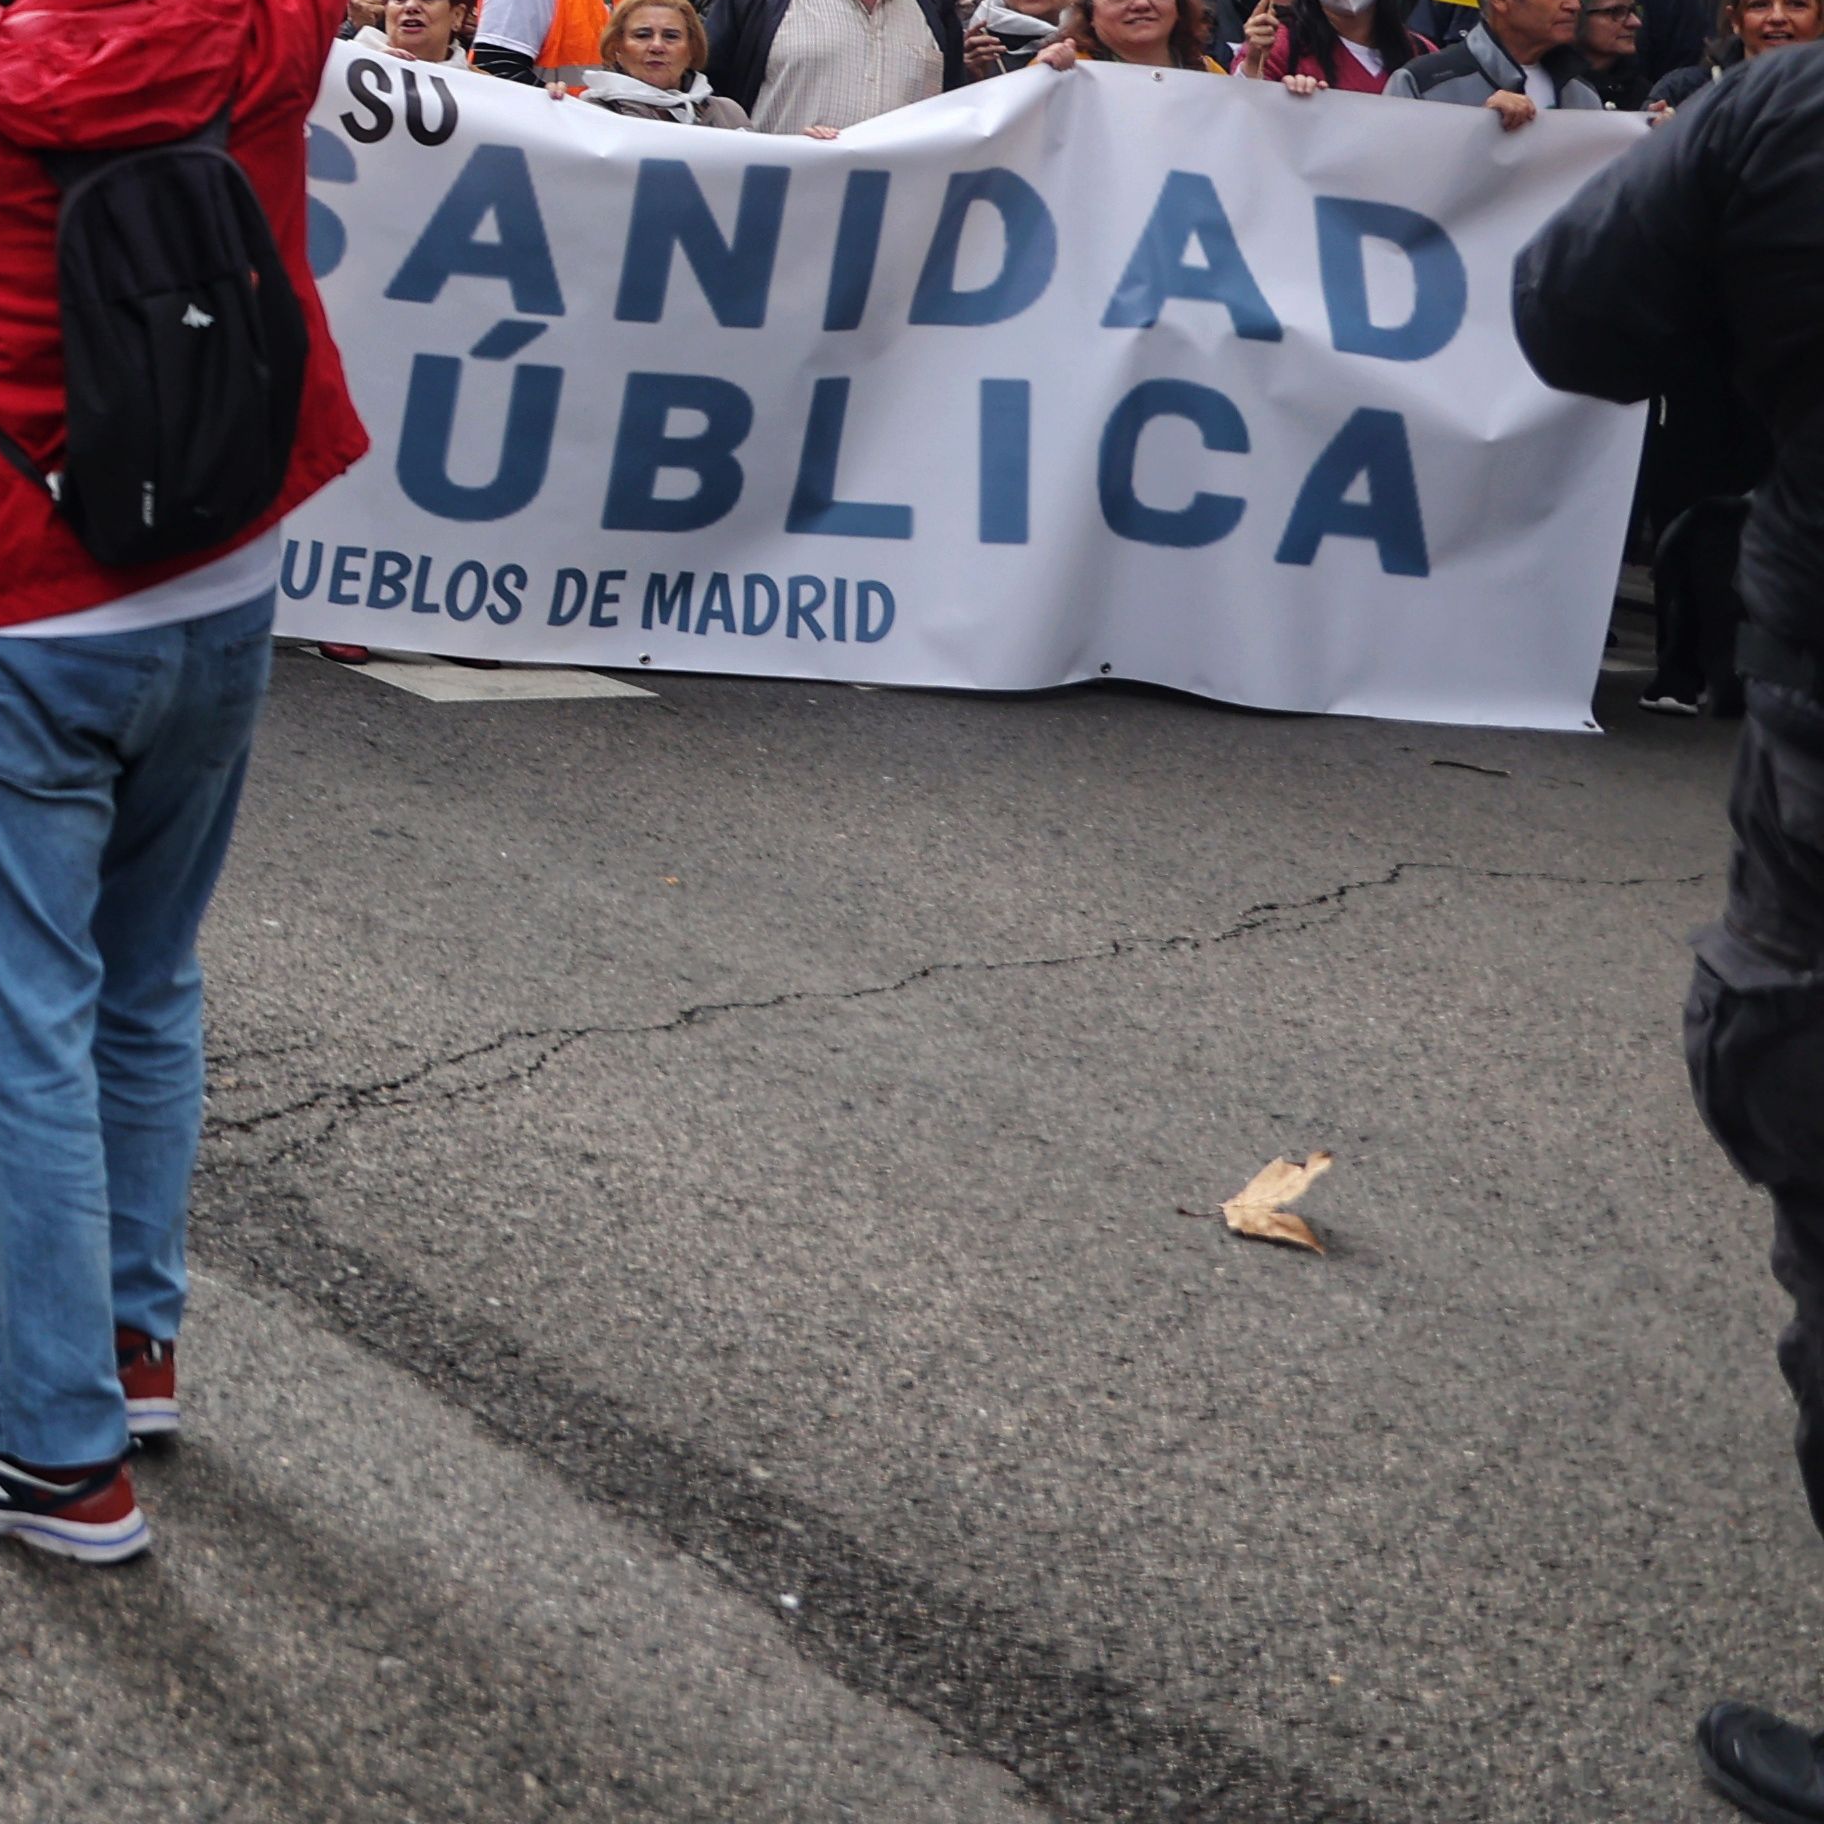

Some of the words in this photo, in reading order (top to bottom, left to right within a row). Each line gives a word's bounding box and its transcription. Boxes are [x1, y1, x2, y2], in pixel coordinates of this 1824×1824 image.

[340, 56, 459, 145] SU
[394, 318, 1432, 578] ÚBLICA
[279, 538, 528, 626] UEBLOS
[547, 566, 628, 629] DE
[640, 570, 896, 644] MADRID
